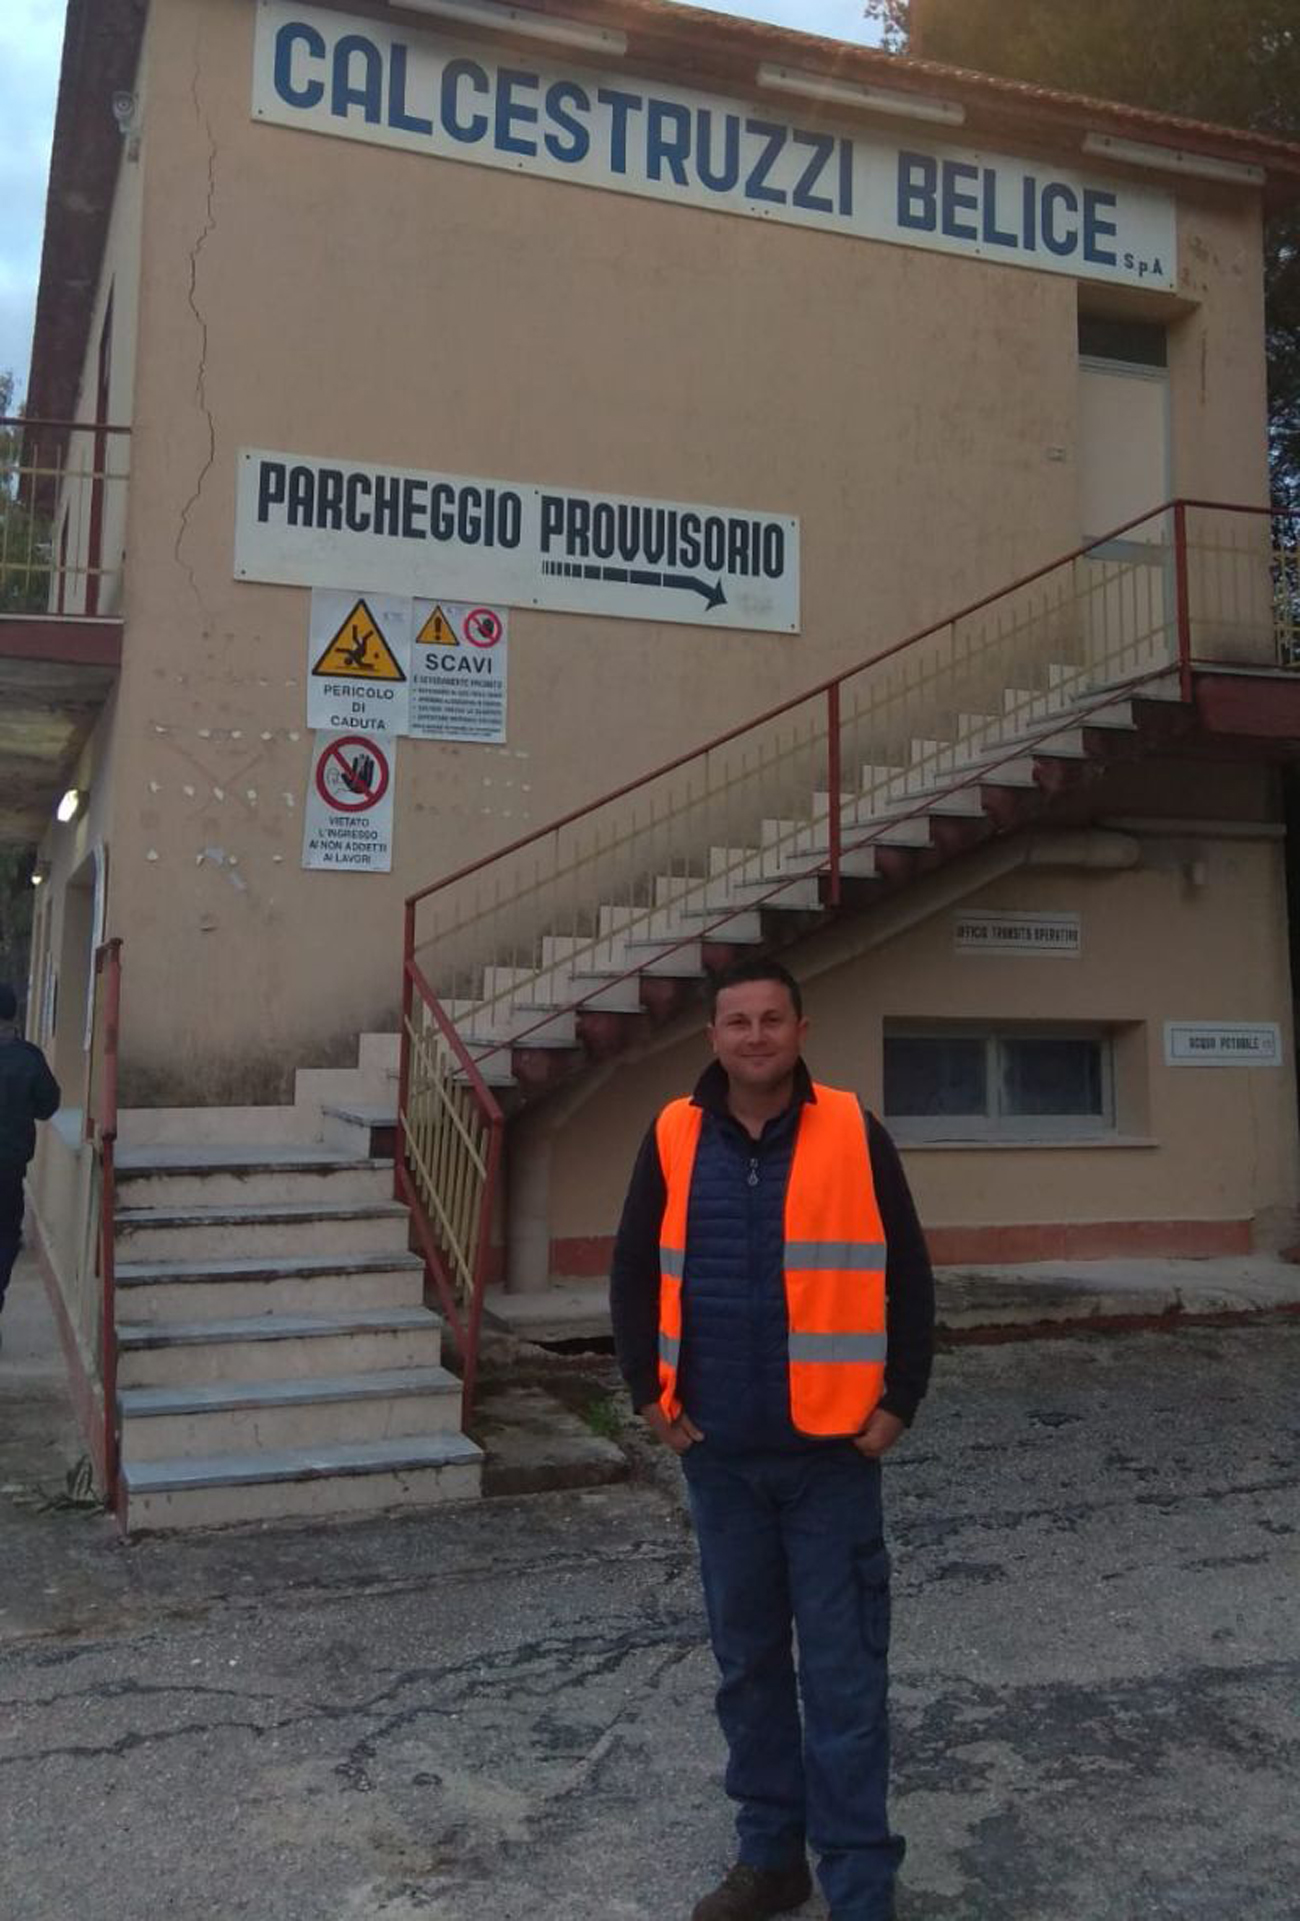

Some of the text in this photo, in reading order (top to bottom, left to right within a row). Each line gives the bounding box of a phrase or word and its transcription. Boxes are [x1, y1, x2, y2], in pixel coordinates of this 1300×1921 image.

[274, 22, 853, 216] CALCESTRUZZI
[898, 150, 1117, 267] BELICE
[257, 461, 785, 579] PARCHEGGIO PROVVISORIO
[425, 653, 492, 674] SCAVI
[323, 684, 394, 700] PERICOLO
[351, 702, 366, 713] DI
[330, 715, 386, 730] CADUTA
[329, 817, 369, 827] VIETATO
[318, 829, 378, 840] L'INGRESSO
[309, 840, 387, 853] AI NON ADDETTI
[335, 853, 371, 864] LAVORI
